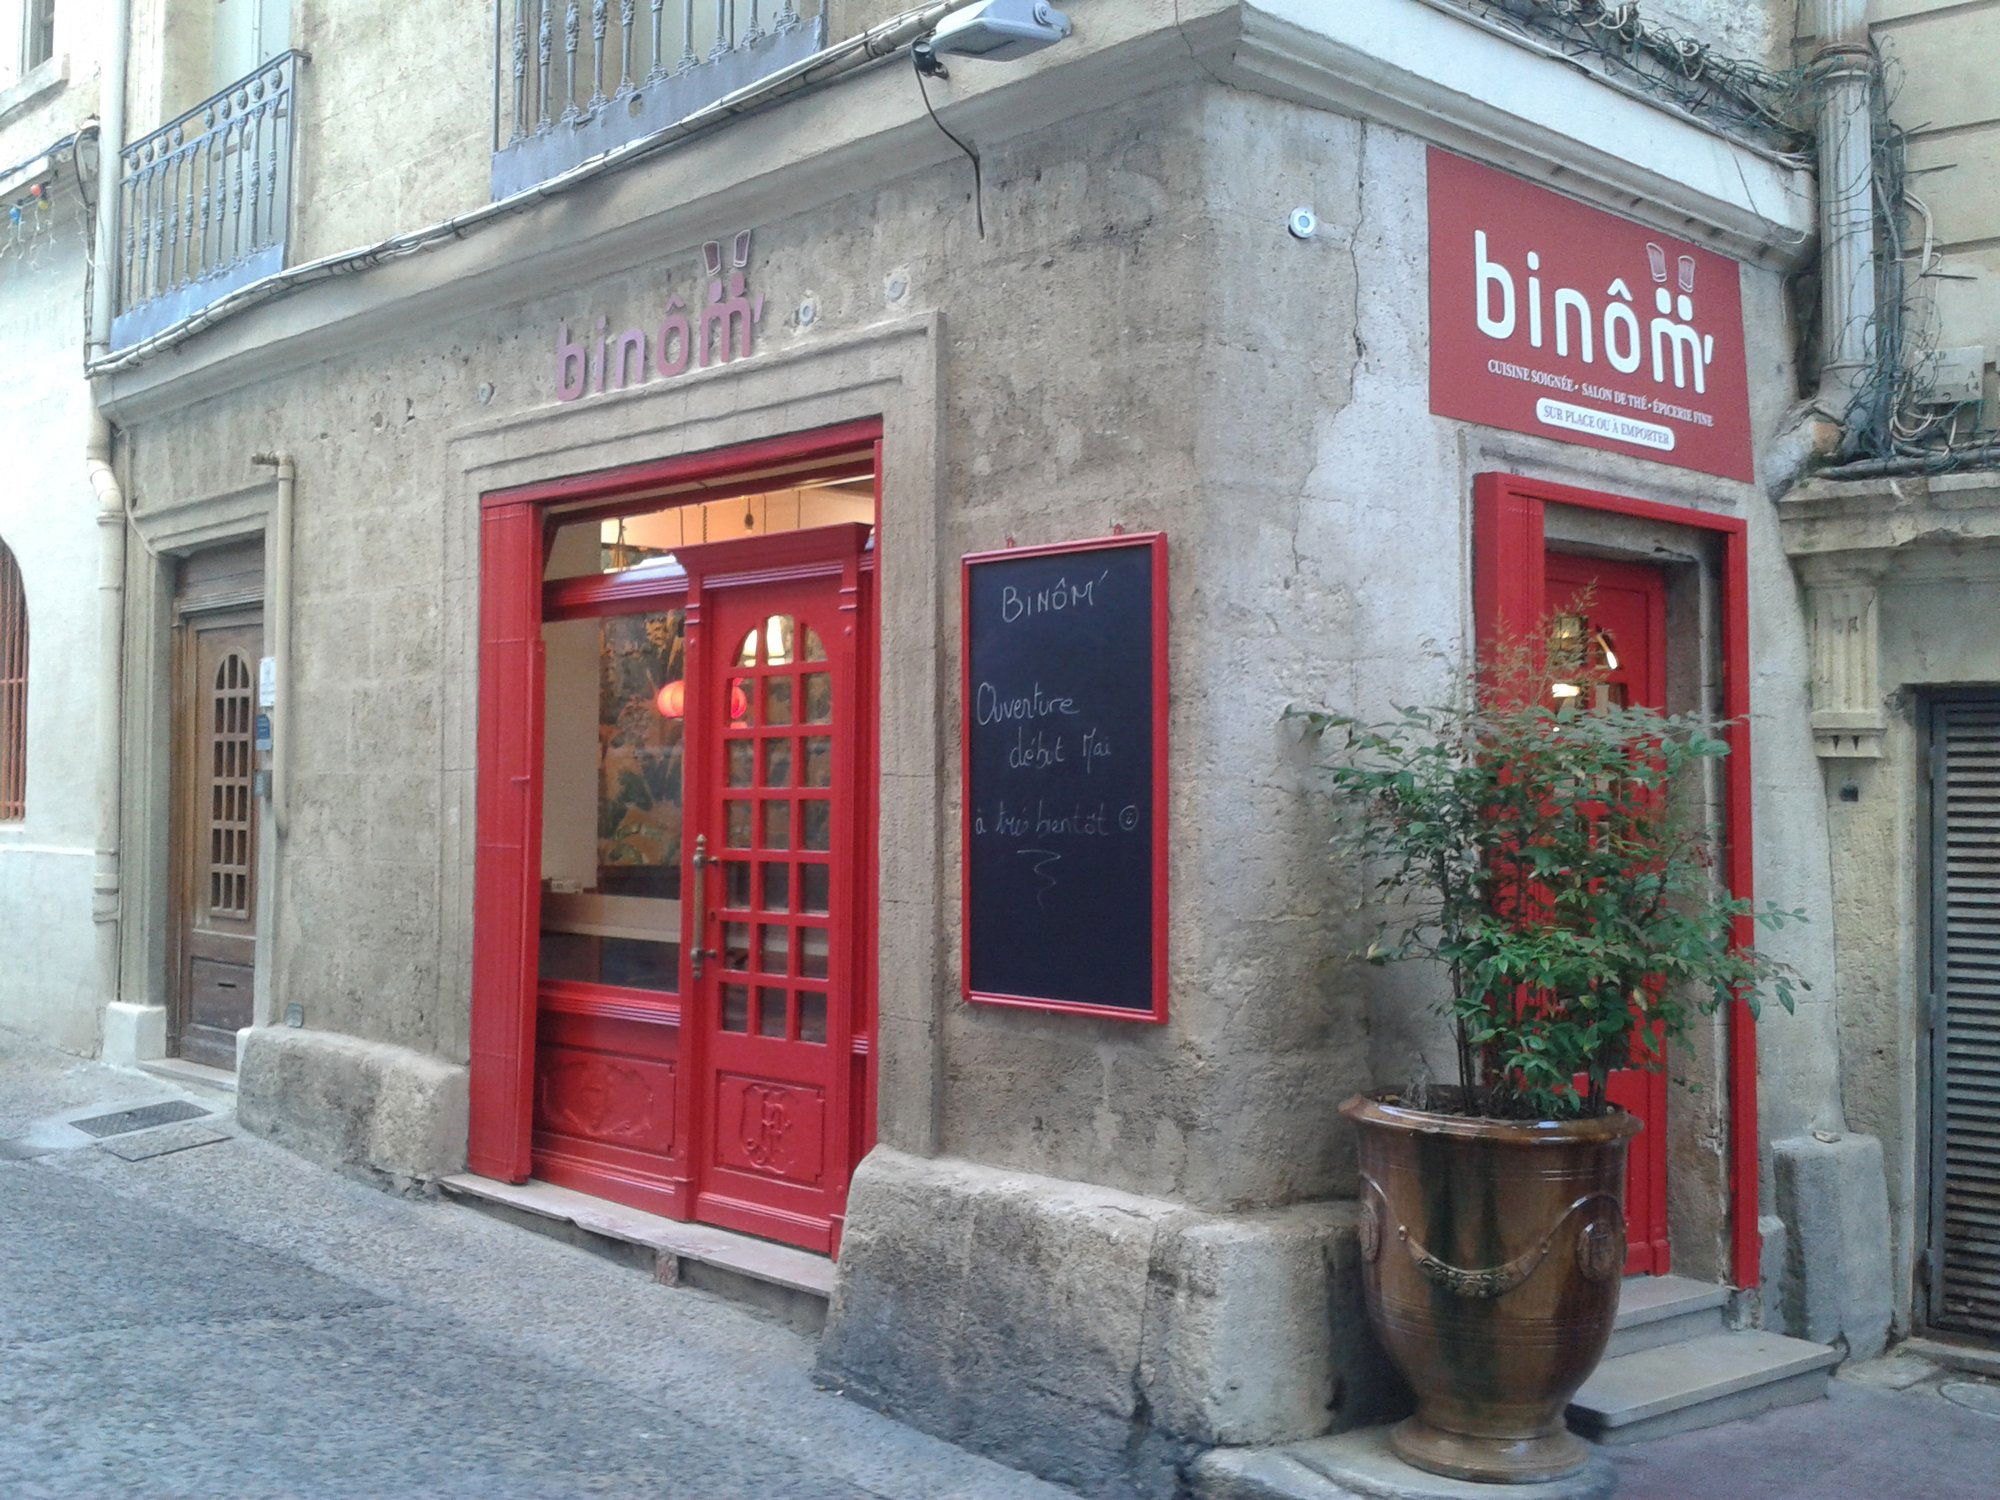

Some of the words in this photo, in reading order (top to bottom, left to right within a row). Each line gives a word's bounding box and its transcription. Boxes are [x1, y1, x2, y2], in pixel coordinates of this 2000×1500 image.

[1488, 359, 1530, 381] CUISINE
[1531, 369, 1574, 391] SOIGNÉE
[1582, 383, 1612, 401] SALON
[1614, 391, 1627, 405] DE
[1628, 395, 1648, 410] THÉ
[1653, 398, 1692, 422] ÉPICERIE
[1693, 411, 1714, 427] FINE
[1544, 405, 1563, 421] SUR
[1565, 410, 1595, 429] PLACE
[1612, 418, 1619, 433] À
[1621, 424, 1669, 445] EMPORTER
[976, 682, 1080, 725] Ouverture
